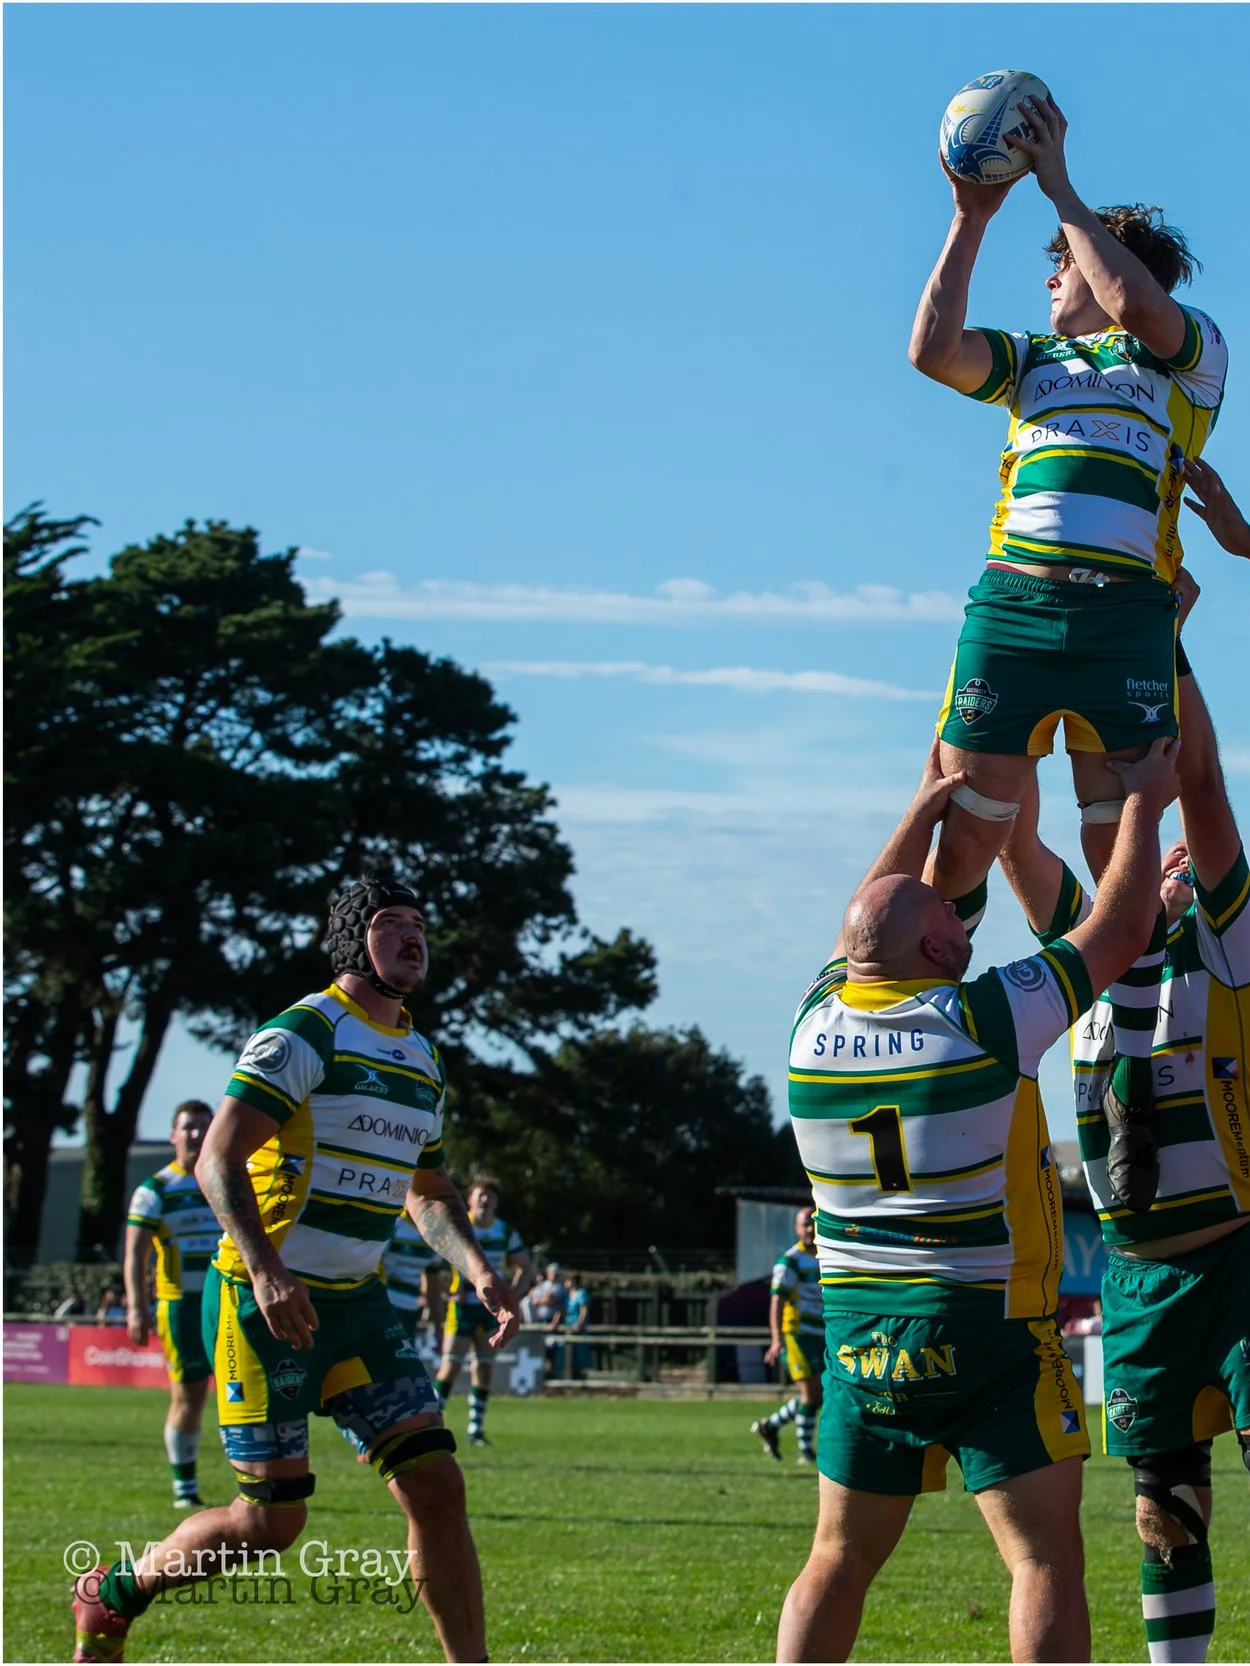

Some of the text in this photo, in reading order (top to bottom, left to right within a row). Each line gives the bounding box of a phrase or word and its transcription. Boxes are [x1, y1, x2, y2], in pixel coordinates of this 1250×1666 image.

[1126, 678, 1168, 691] fletcher
[957, 696, 993, 710] RAIDERS
[813, 1028, 925, 1058] SPRING
[354, 1083, 389, 1095] GILBERT
[347, 1114, 430, 1146] DOMINIO
[848, 1105, 912, 1193] 1
[836, 1344, 957, 1382] SWAN
